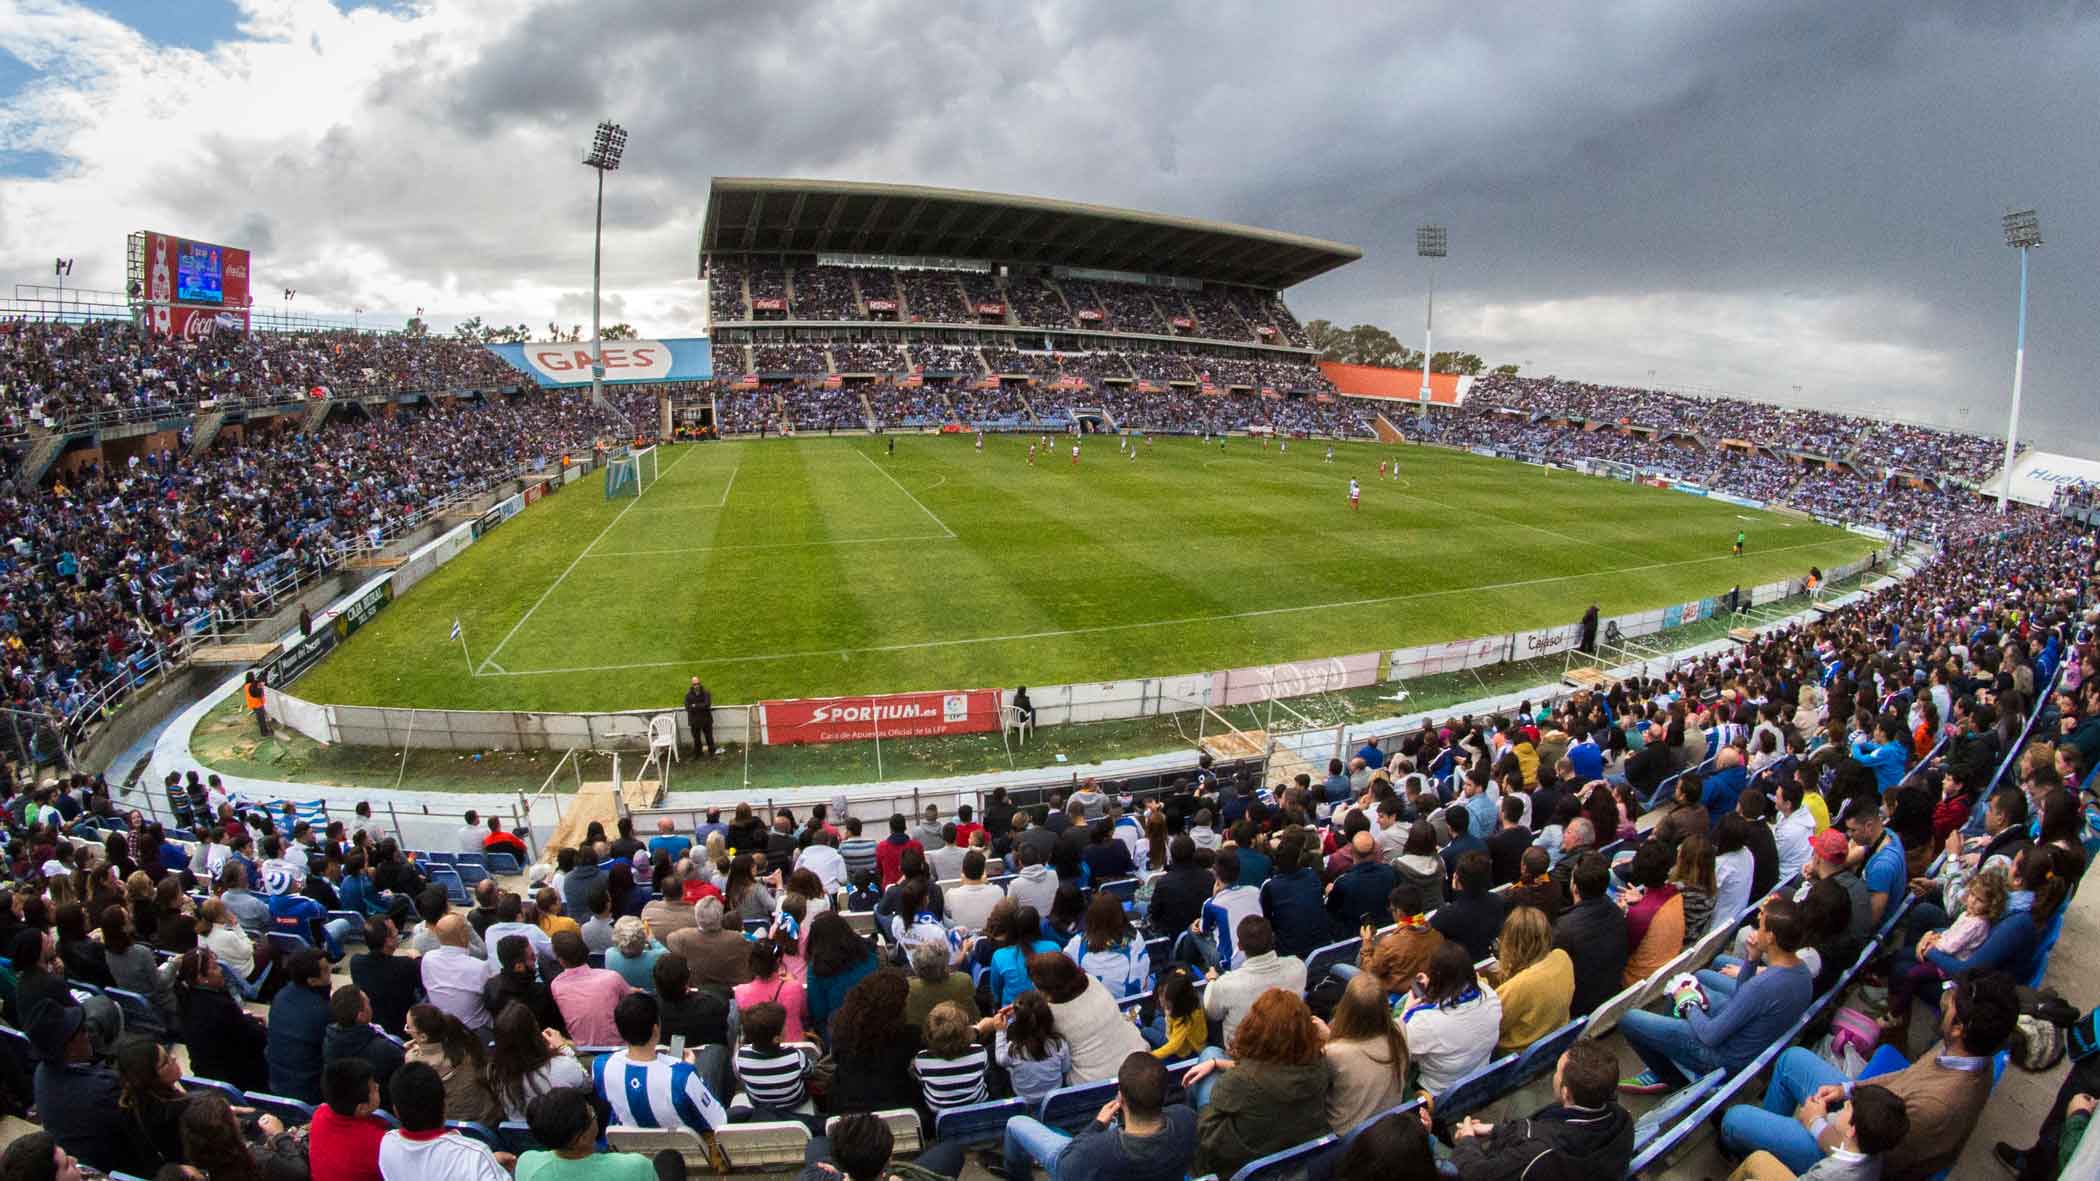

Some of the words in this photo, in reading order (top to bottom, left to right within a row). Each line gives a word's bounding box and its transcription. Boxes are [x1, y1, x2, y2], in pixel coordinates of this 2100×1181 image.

[537, 348, 656, 371] GAES
[801, 703, 937, 724] SPORTIUM.es
[851, 728, 887, 740] Apuesas
[887, 727, 913, 737] Oficial
